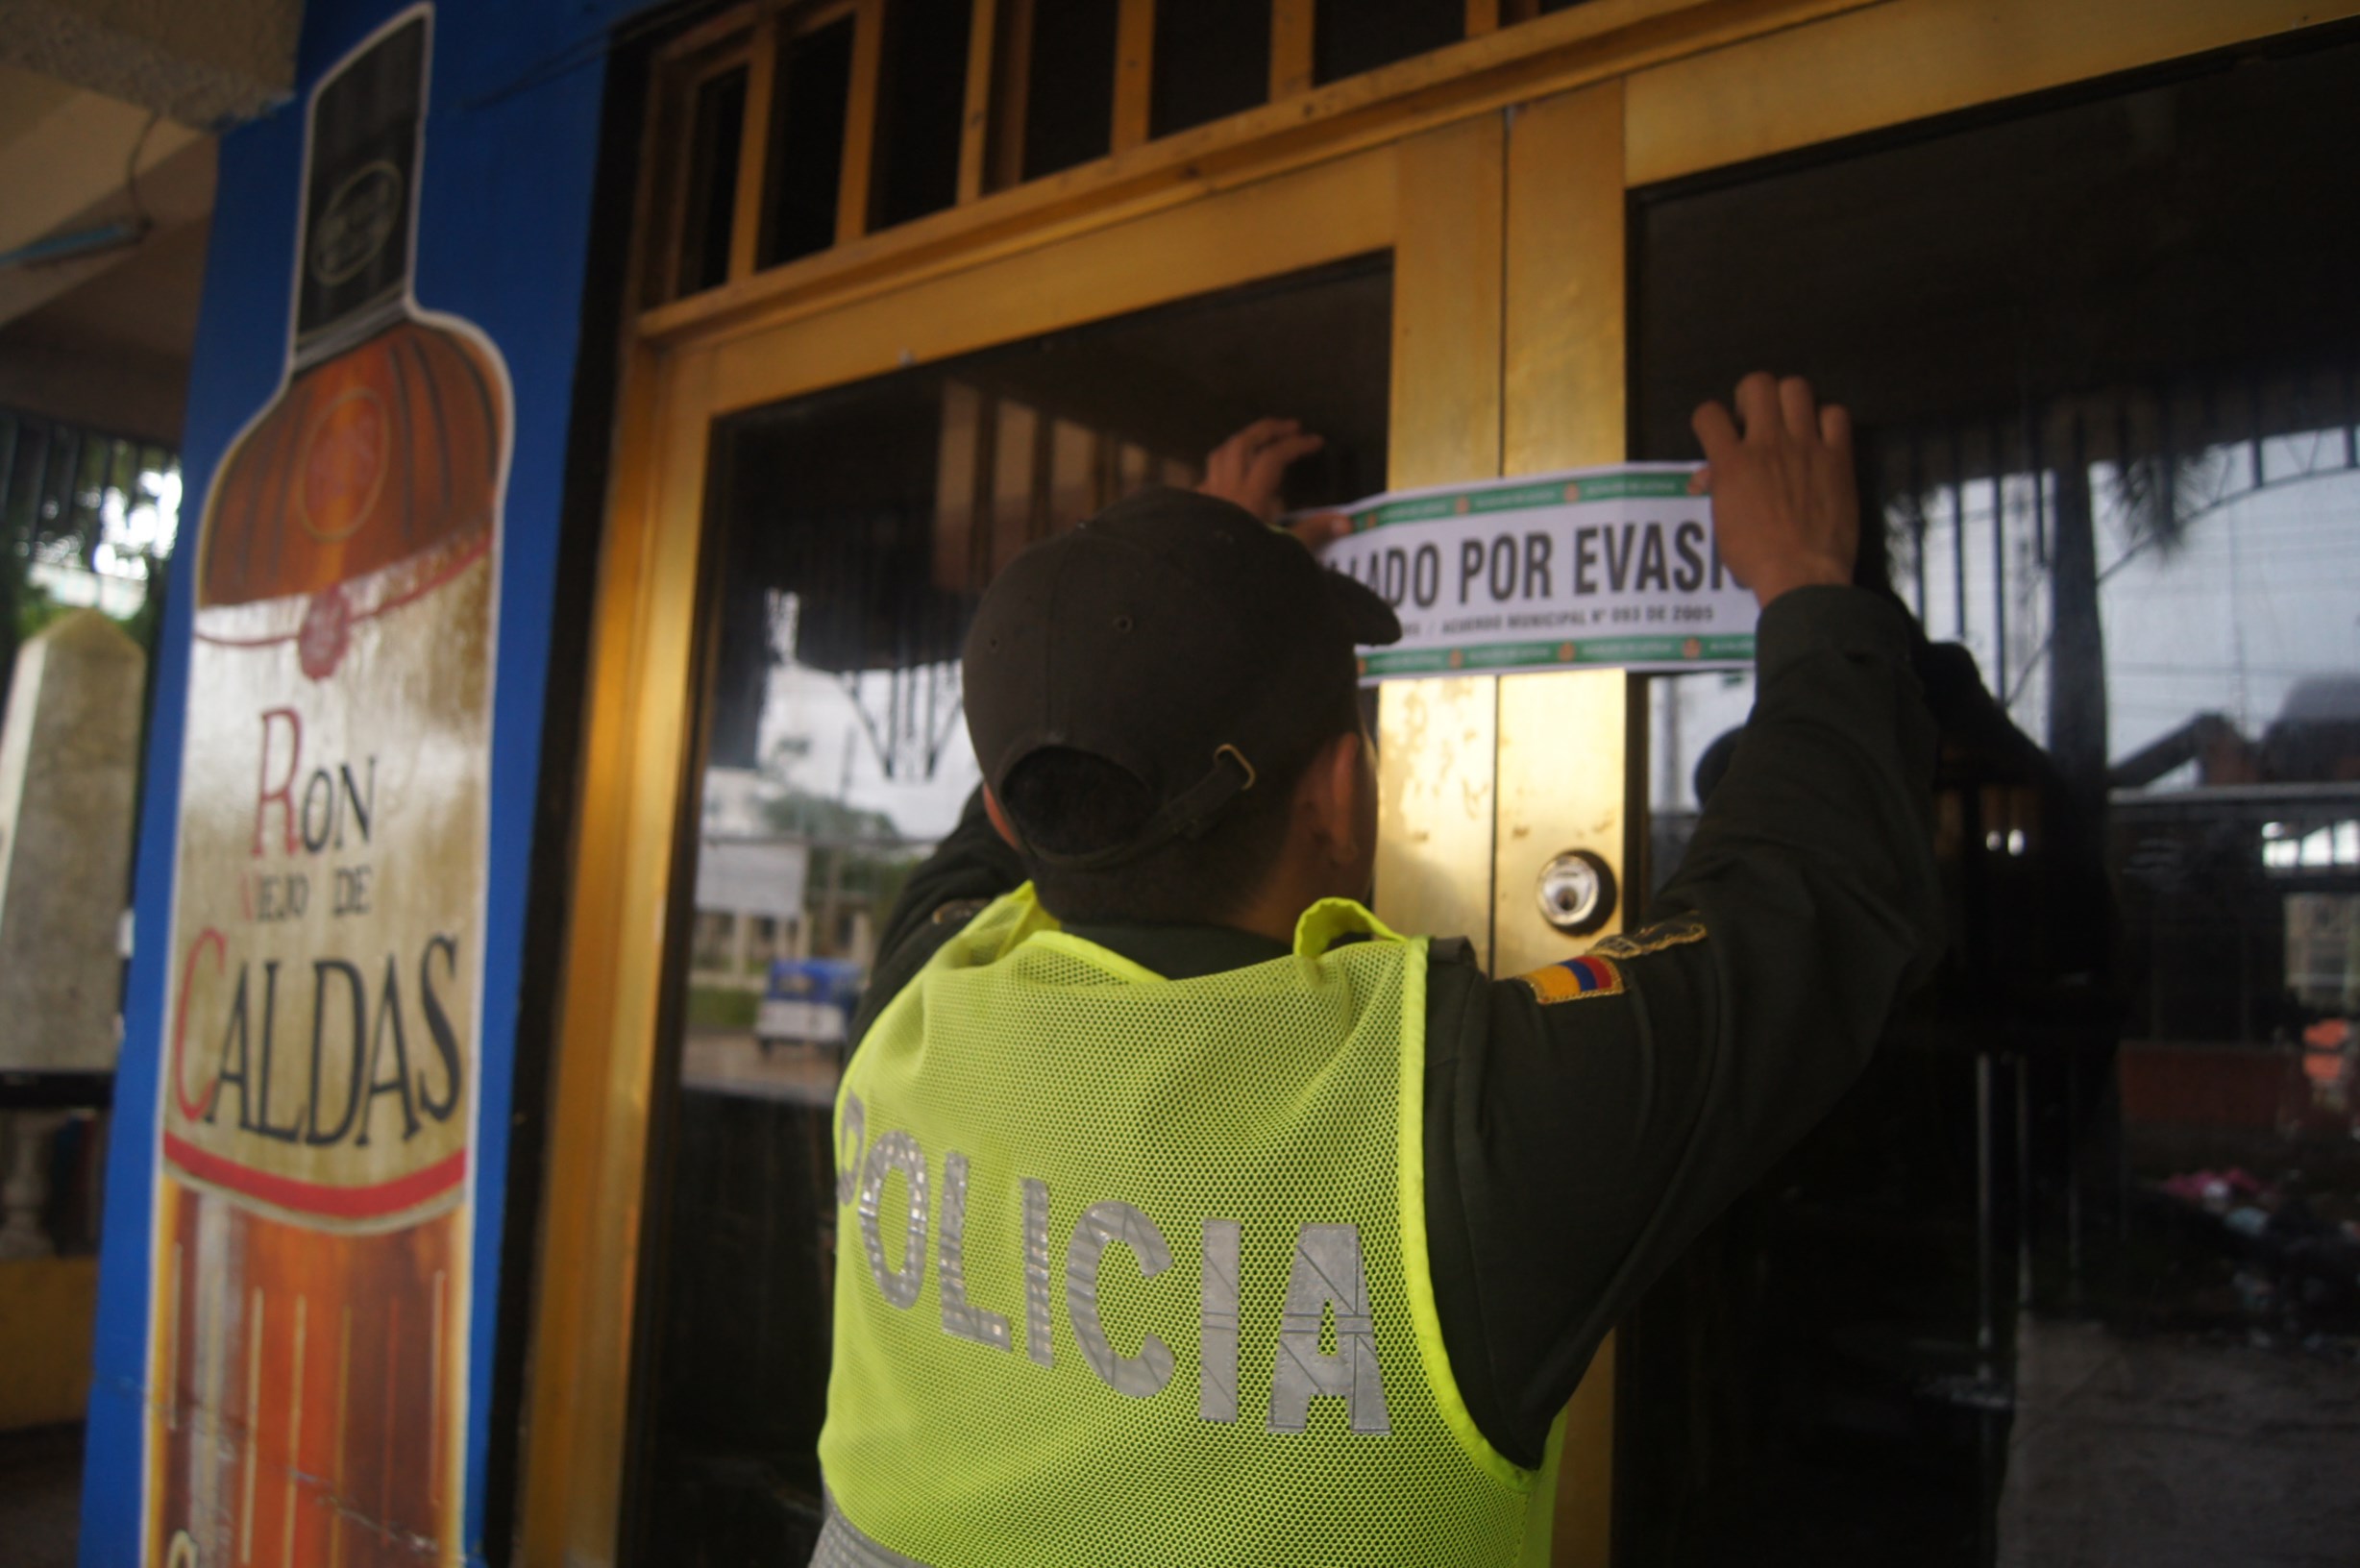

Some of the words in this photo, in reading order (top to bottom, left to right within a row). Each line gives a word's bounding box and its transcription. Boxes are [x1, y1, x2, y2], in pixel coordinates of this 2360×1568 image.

[1459, 531, 1553, 605] POR
[1574, 520, 1753, 597] EVASI
[1508, 609, 1586, 631] MUNICIPAL
[1646, 605, 1667, 622] DE
[250, 706, 377, 858] RON
[332, 865, 373, 919] DE
[173, 927, 463, 1148] CALDAS
[836, 1087, 1391, 1434] POLICIA
